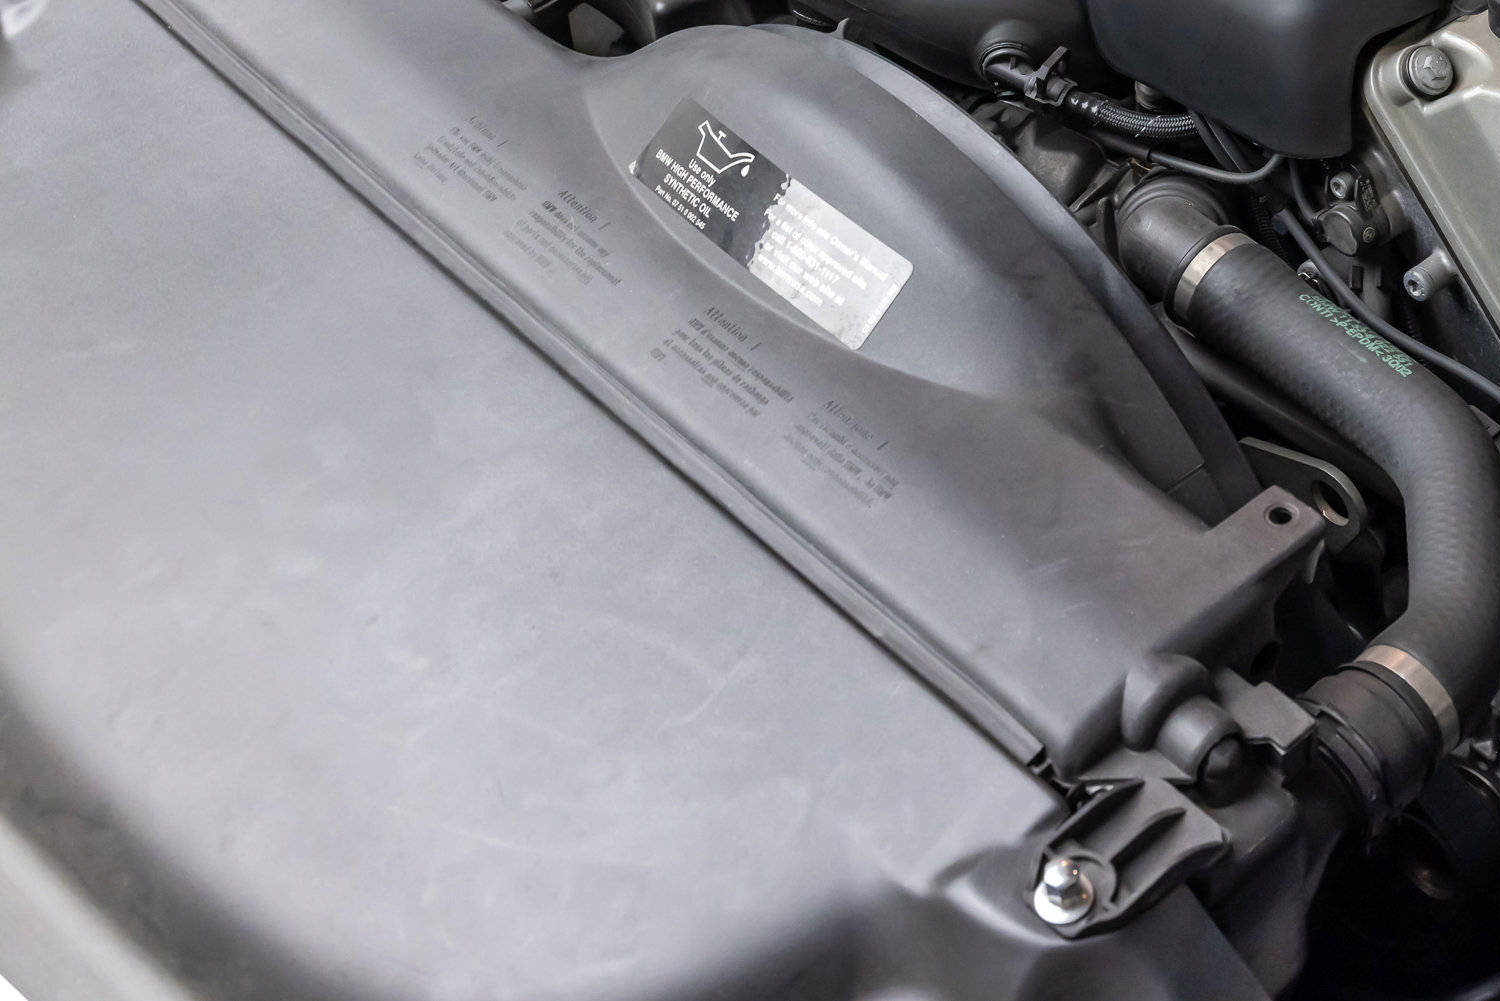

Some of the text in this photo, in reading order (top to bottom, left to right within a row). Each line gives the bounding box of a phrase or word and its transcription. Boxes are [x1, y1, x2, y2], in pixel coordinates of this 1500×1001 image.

[655, 149, 740, 222] BMW HIGH PERFORMANCE
[688, 158, 716, 187] Use only
[655, 185, 665, 197] Part
[663, 192, 672, 203] No.
[671, 198, 679, 208] 07
[677, 204, 685, 212] 51
[663, 173, 712, 219] SYNTHETIC OIL
[803, 271, 820, 288] web
[1299, 294, 1333, 319] CONTI
